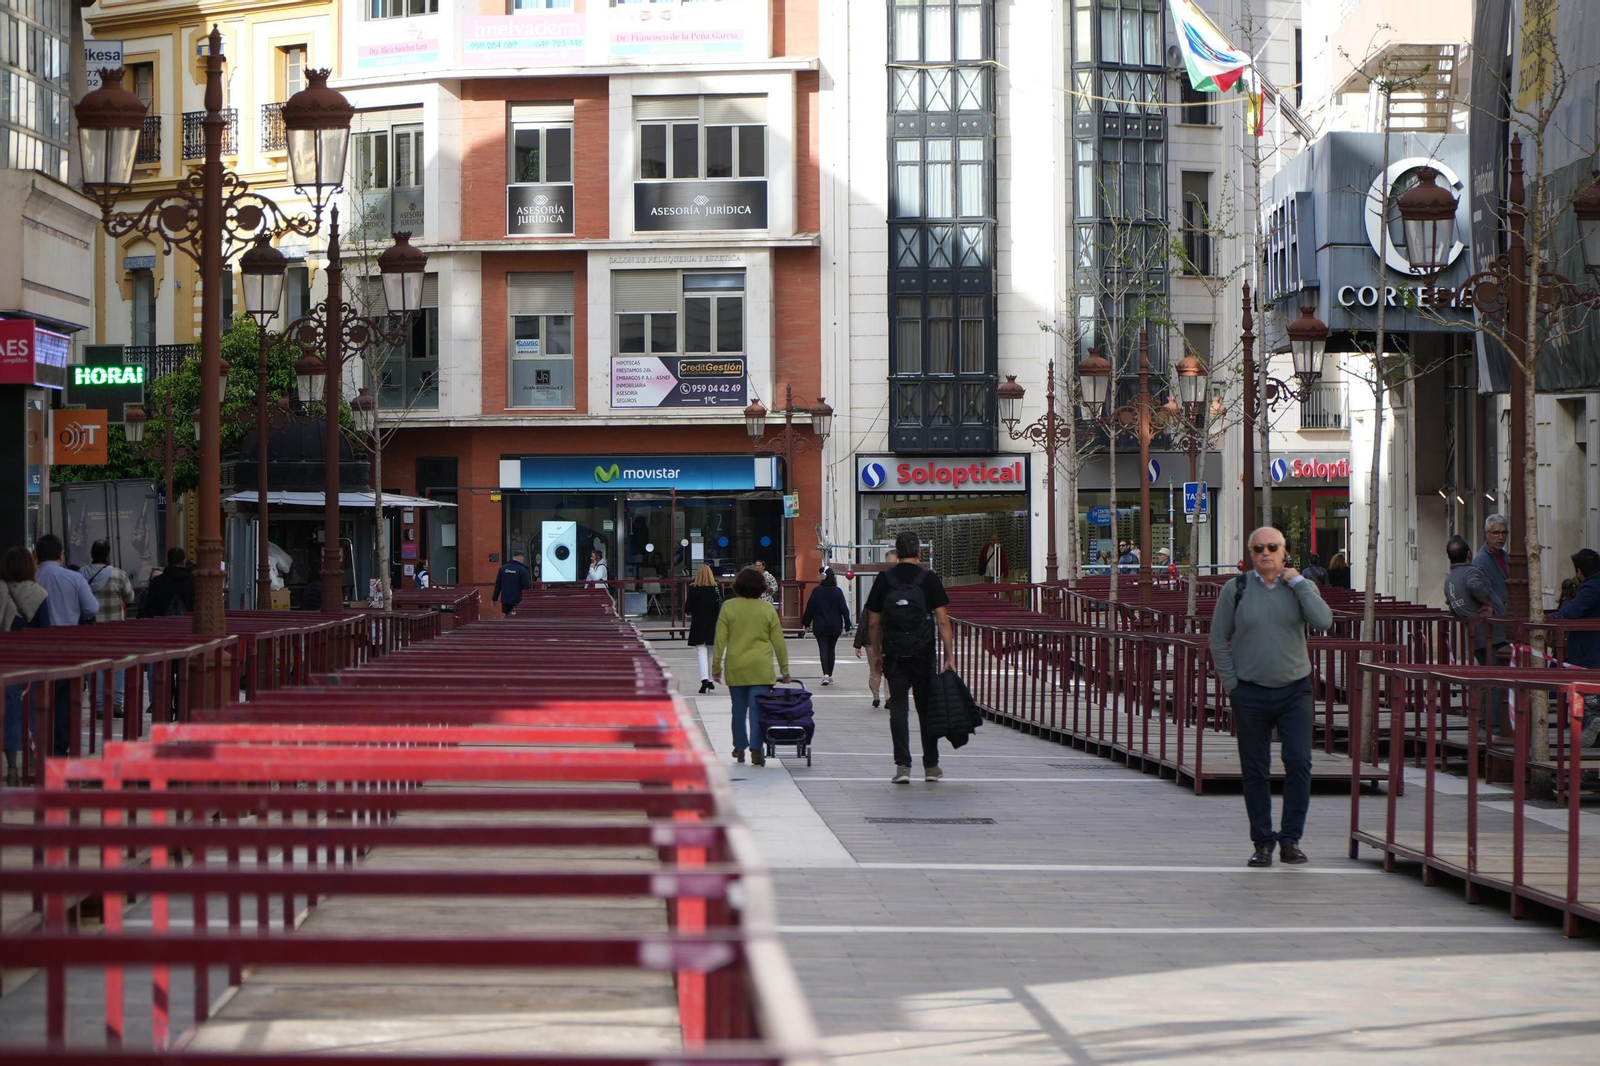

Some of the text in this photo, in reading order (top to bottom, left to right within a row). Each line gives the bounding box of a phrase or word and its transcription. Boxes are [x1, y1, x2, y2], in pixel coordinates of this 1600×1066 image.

[473, 19, 580, 38] huelvaderm
[670, 33, 680, 41] de
[682, 32, 689, 40] la
[84, 48, 120, 61] ikesa
[516, 205, 565, 215] ASESORÍA
[650, 204, 752, 217] ASESORÍA JURÍDICA
[518, 214, 564, 226] JURÍDICA
[680, 362, 742, 372] CreditGestión
[692, 384, 706, 392] 959
[708, 384, 718, 392] 04
[731, 384, 741, 392] 49
[623, 468, 680, 479] movistar
[896, 462, 1021, 488] Soloptical
[1291, 458, 1350, 482] Solopti
